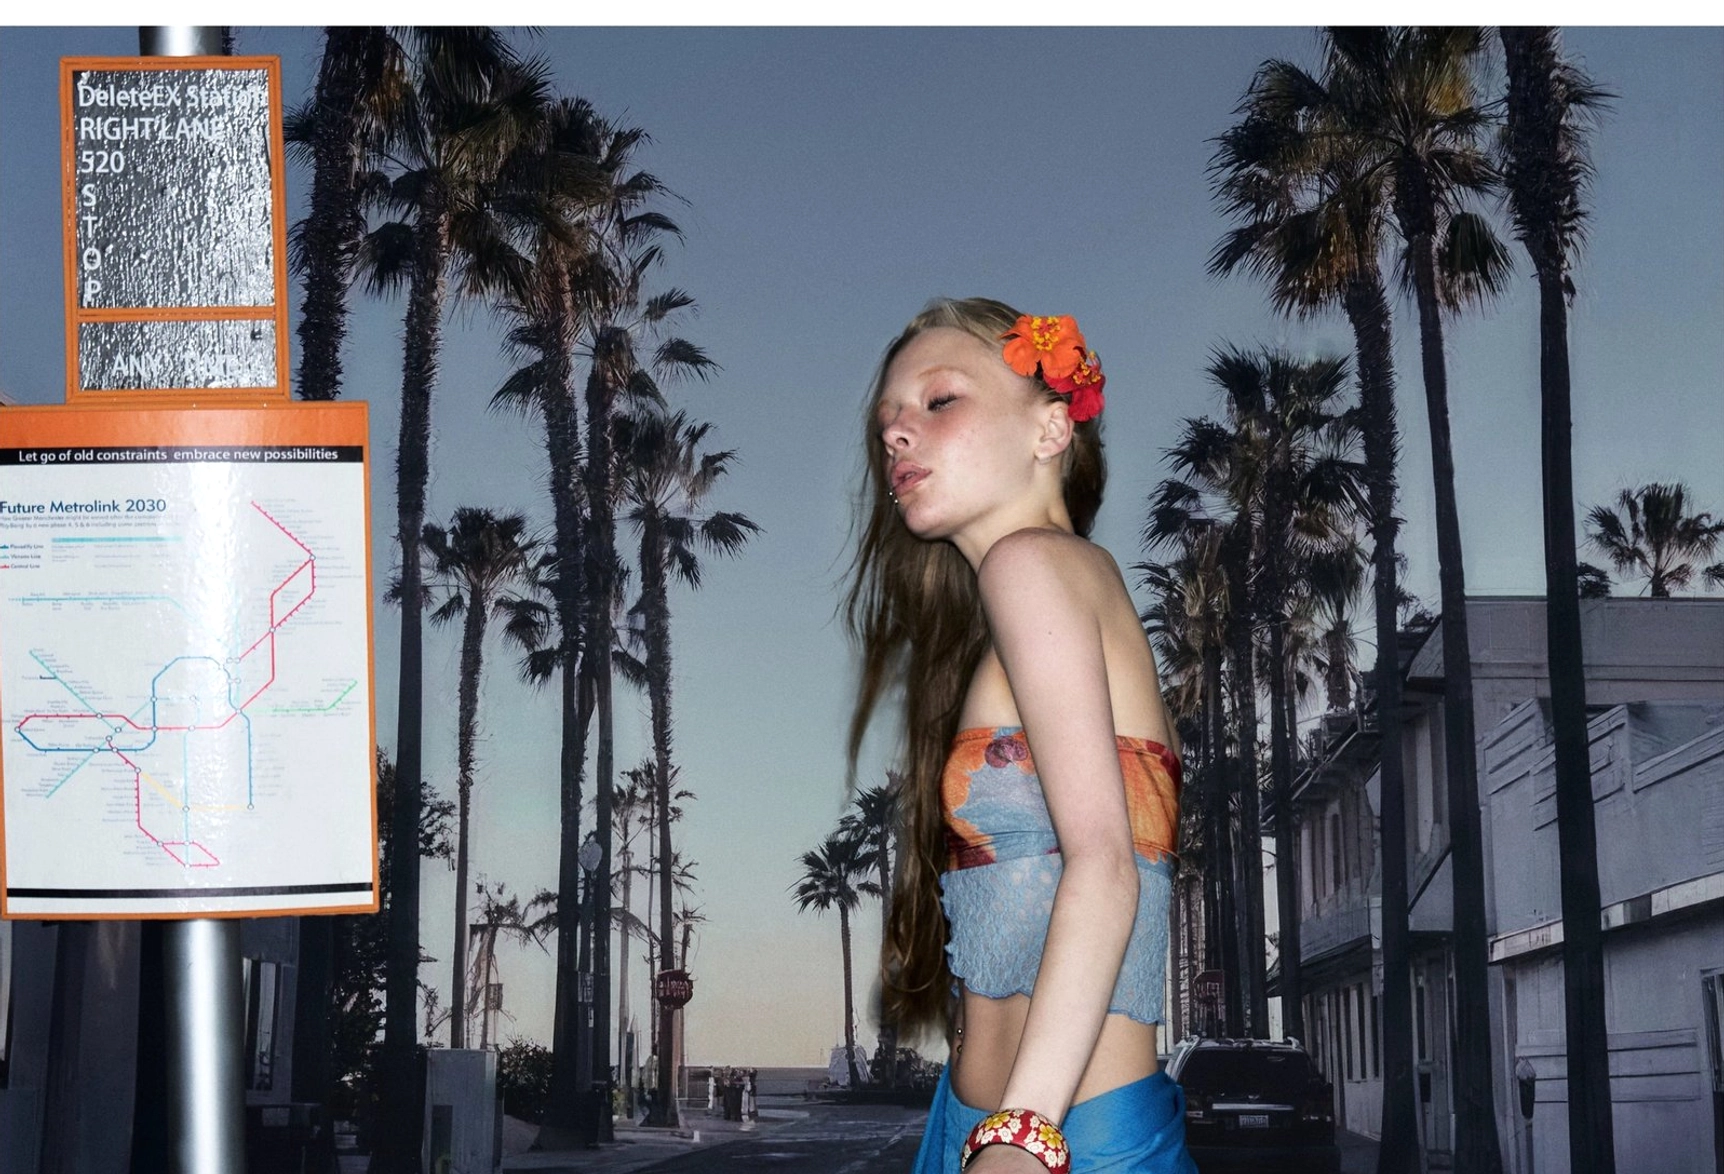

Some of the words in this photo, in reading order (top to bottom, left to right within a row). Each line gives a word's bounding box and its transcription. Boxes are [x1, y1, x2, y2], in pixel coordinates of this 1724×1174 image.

[78, 85, 181, 107] DeleteEX
[80, 117, 155, 140] RIGHT
[81, 150, 125, 173] 520
[19, 450, 37, 462] Let
[40, 452, 56, 465] go
[58, 449, 72, 461] of
[74, 449, 93, 461] old
[96, 448, 167, 461] constraints
[173, 448, 230, 460] embrace
[233, 450, 261, 460] new
[264, 448, 338, 462] possibilities
[0, 501, 45, 514] Future
[50, 499, 121, 513] Metrolink
[125, 498, 167, 512] 2030
